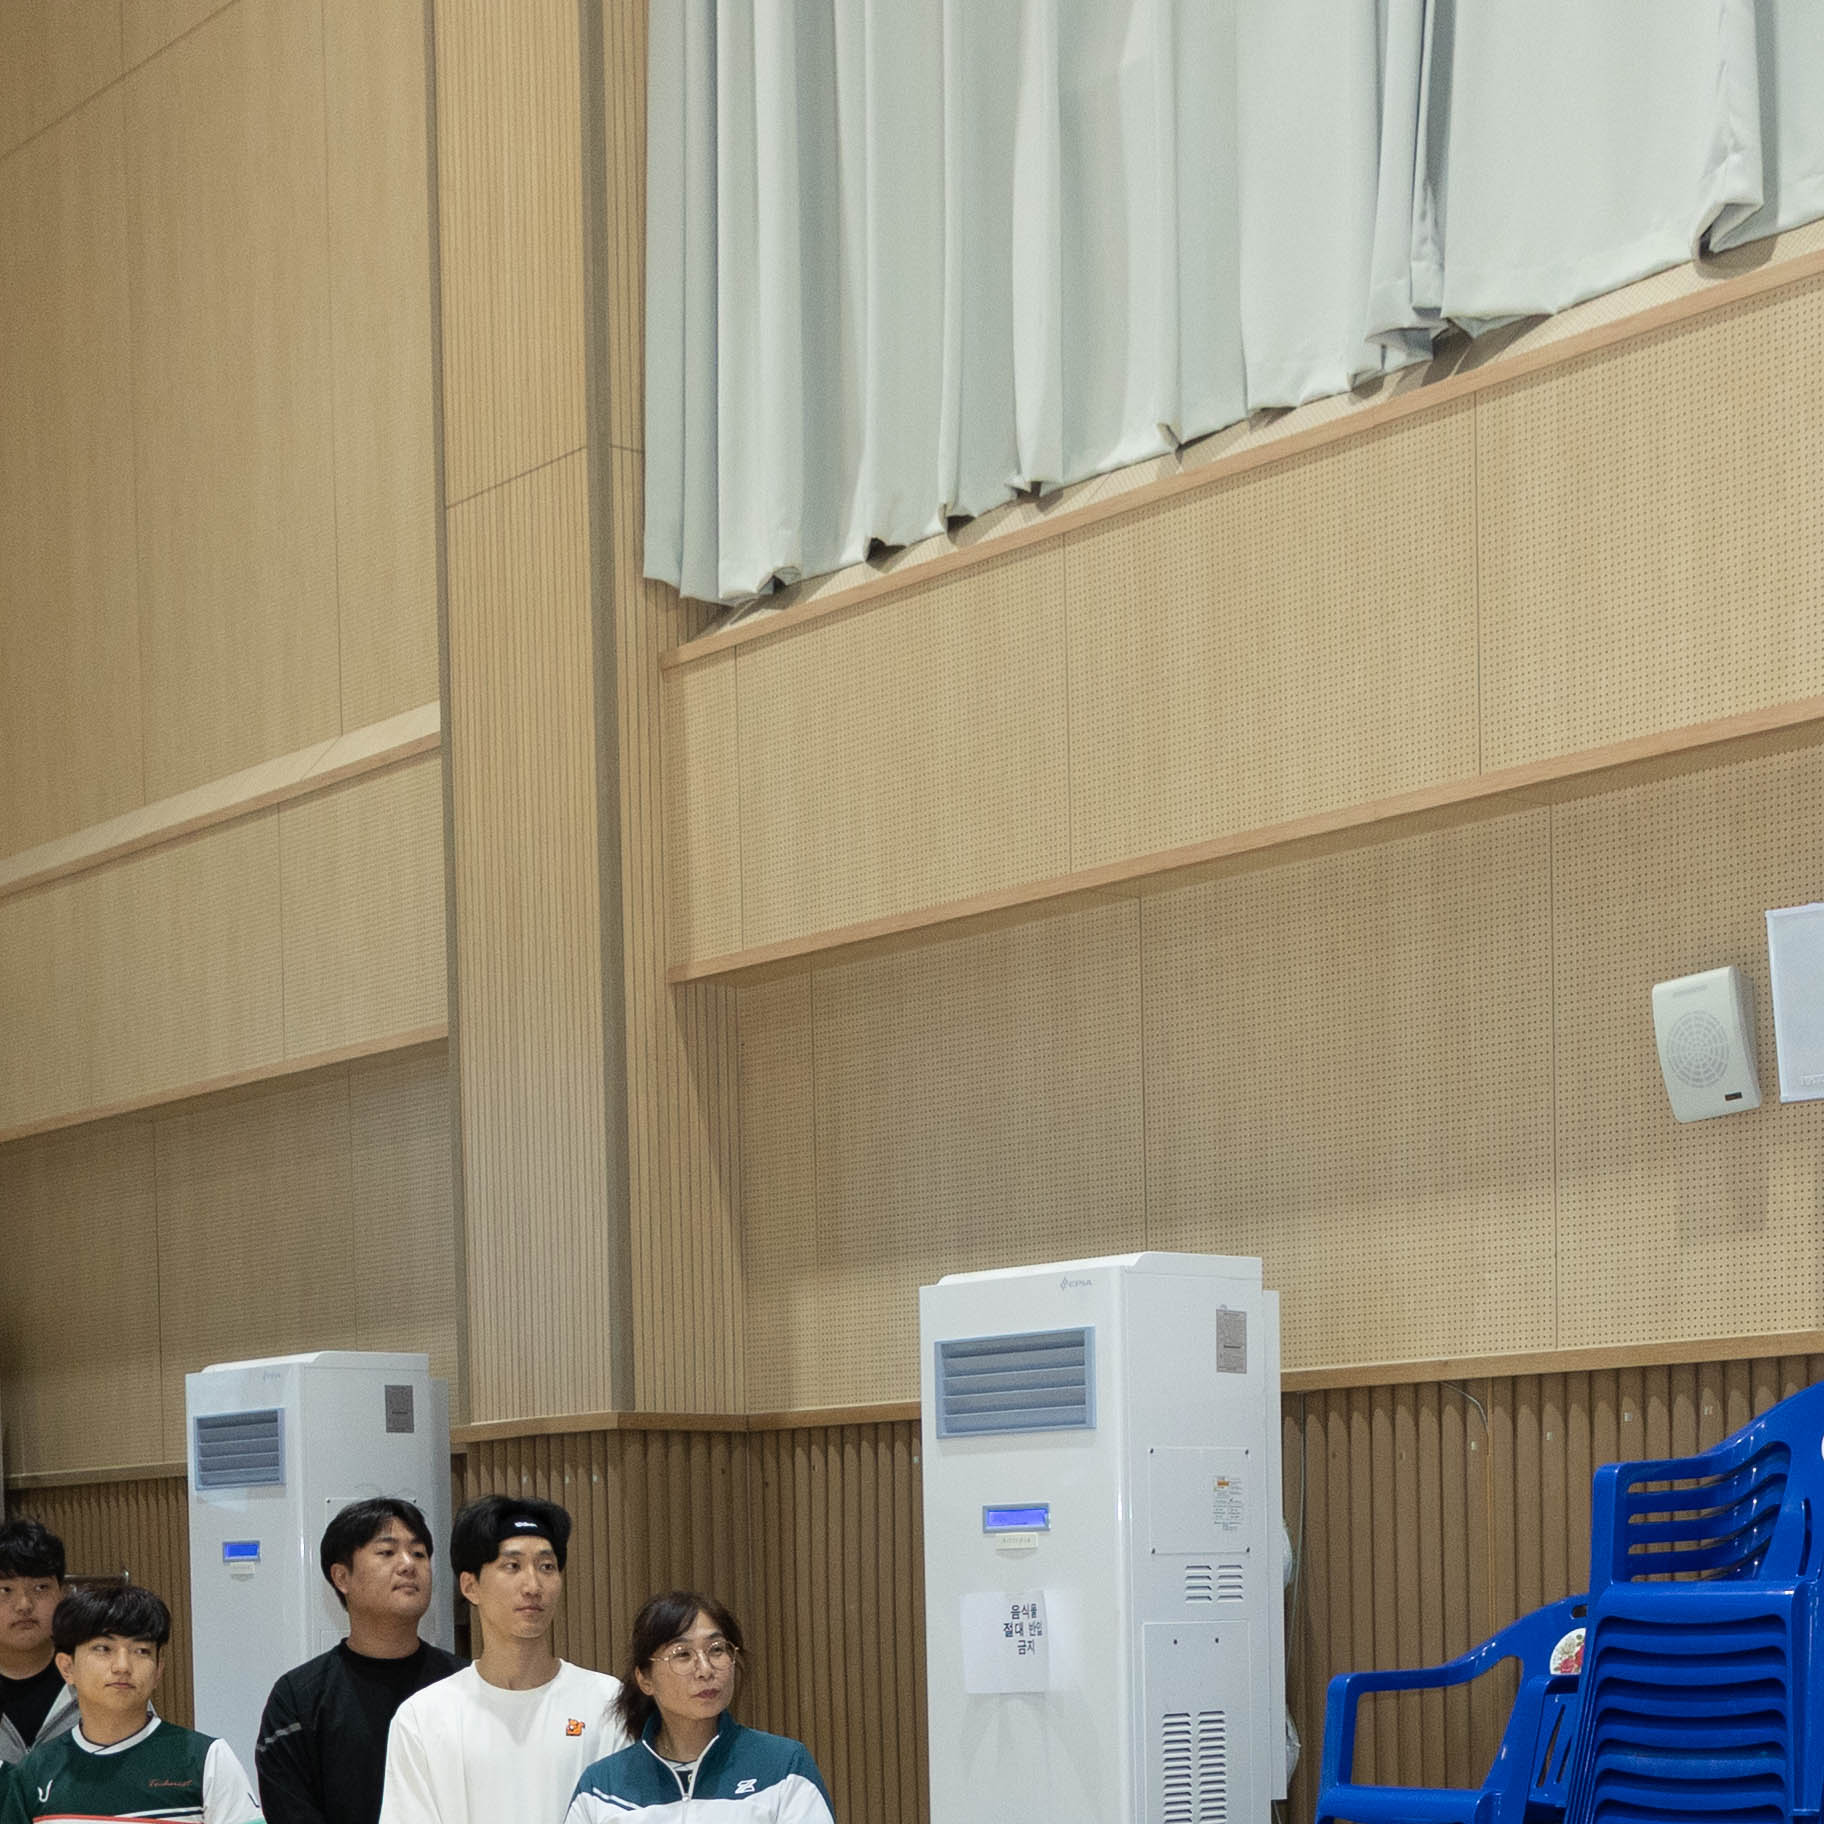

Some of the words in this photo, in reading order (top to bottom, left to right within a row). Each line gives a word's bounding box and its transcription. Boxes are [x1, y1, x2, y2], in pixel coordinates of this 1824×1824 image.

[1010, 1602, 1038, 1619] 음식물
[1003, 1621, 1025, 1638] 절대
[1017, 1639, 1035, 1656] 금지
